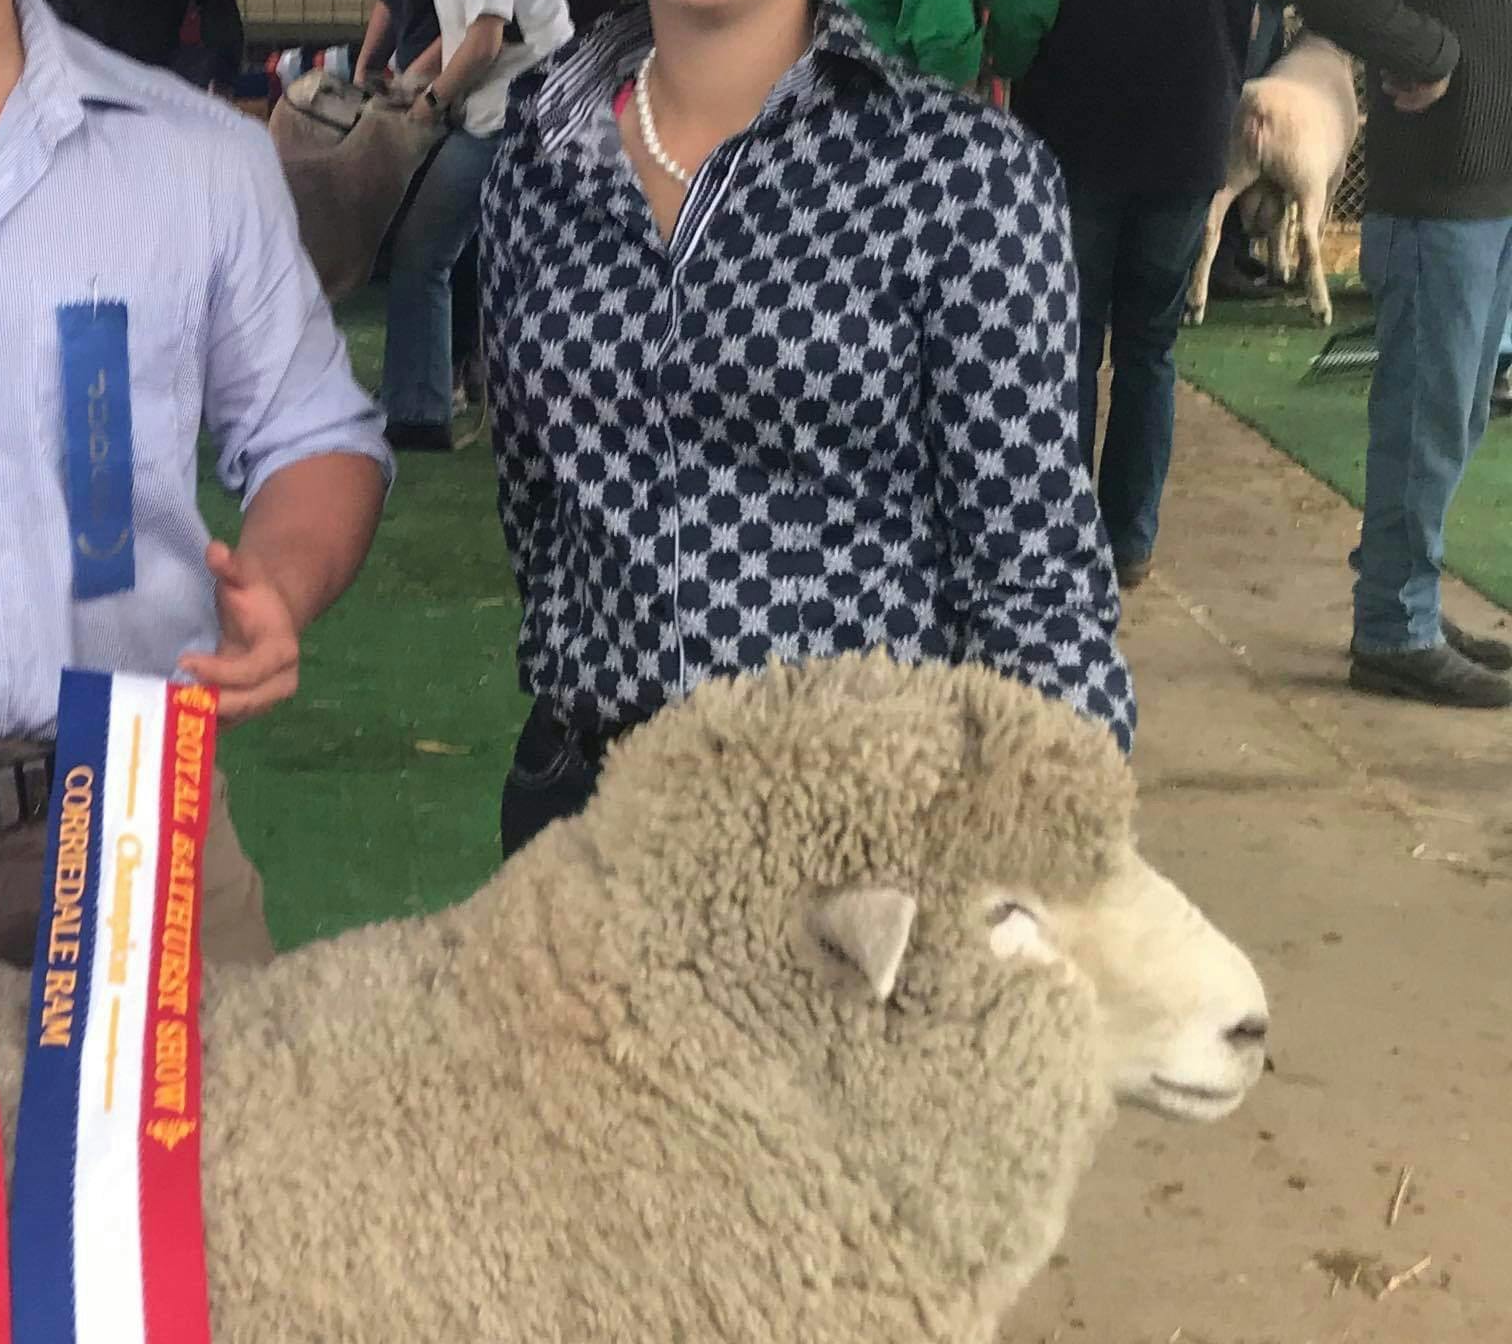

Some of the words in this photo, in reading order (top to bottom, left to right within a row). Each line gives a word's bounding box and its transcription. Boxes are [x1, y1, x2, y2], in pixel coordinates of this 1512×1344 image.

[173, 709, 206, 824] ROYAL
[48, 764, 95, 965] CORRIEDALE
[158, 829, 195, 1016] BATHURST
[40, 968, 78, 1048] RAM
[153, 1019, 188, 1115] SHOW
